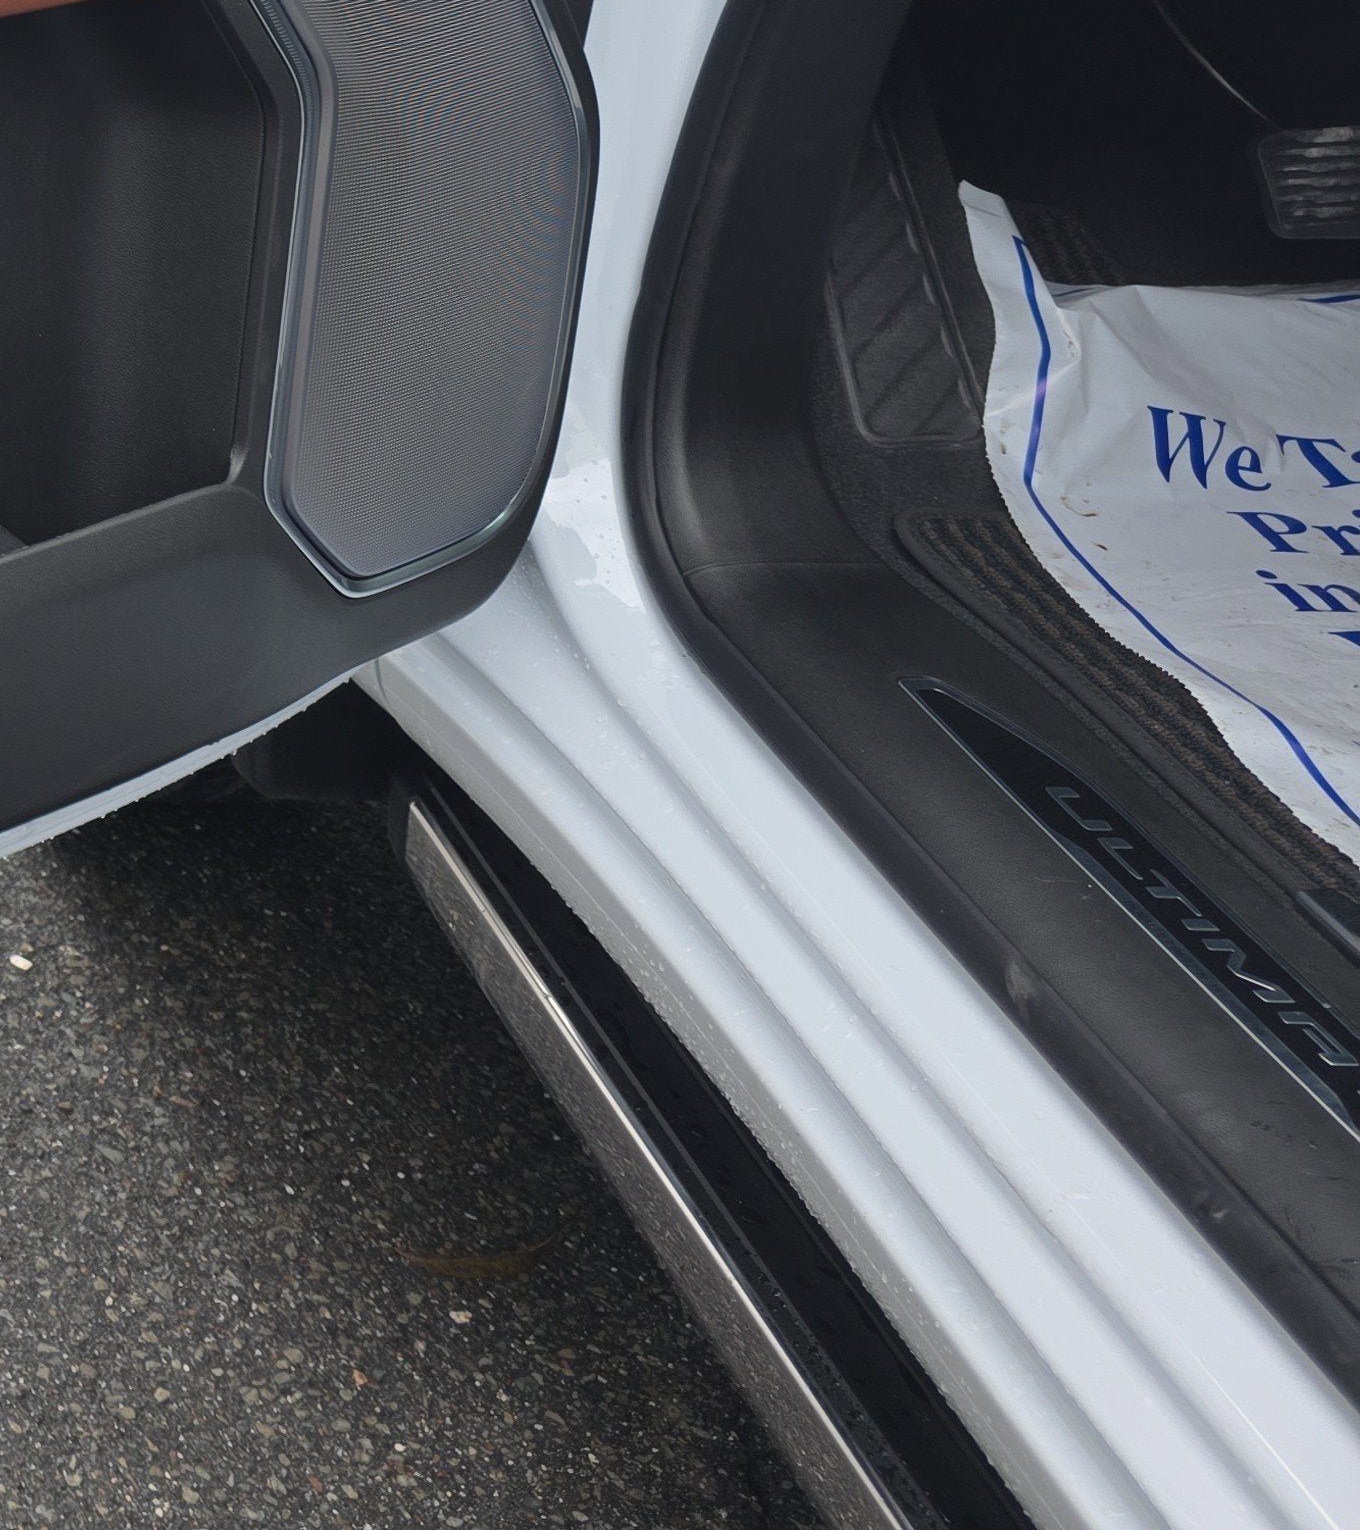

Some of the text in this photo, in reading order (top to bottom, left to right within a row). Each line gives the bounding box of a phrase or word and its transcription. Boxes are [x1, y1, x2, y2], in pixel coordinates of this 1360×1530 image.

[1147, 405, 1360, 492] We T
[1226, 509, 1360, 556] Pr
[1046, 786, 1360, 1070] ULTIMA
